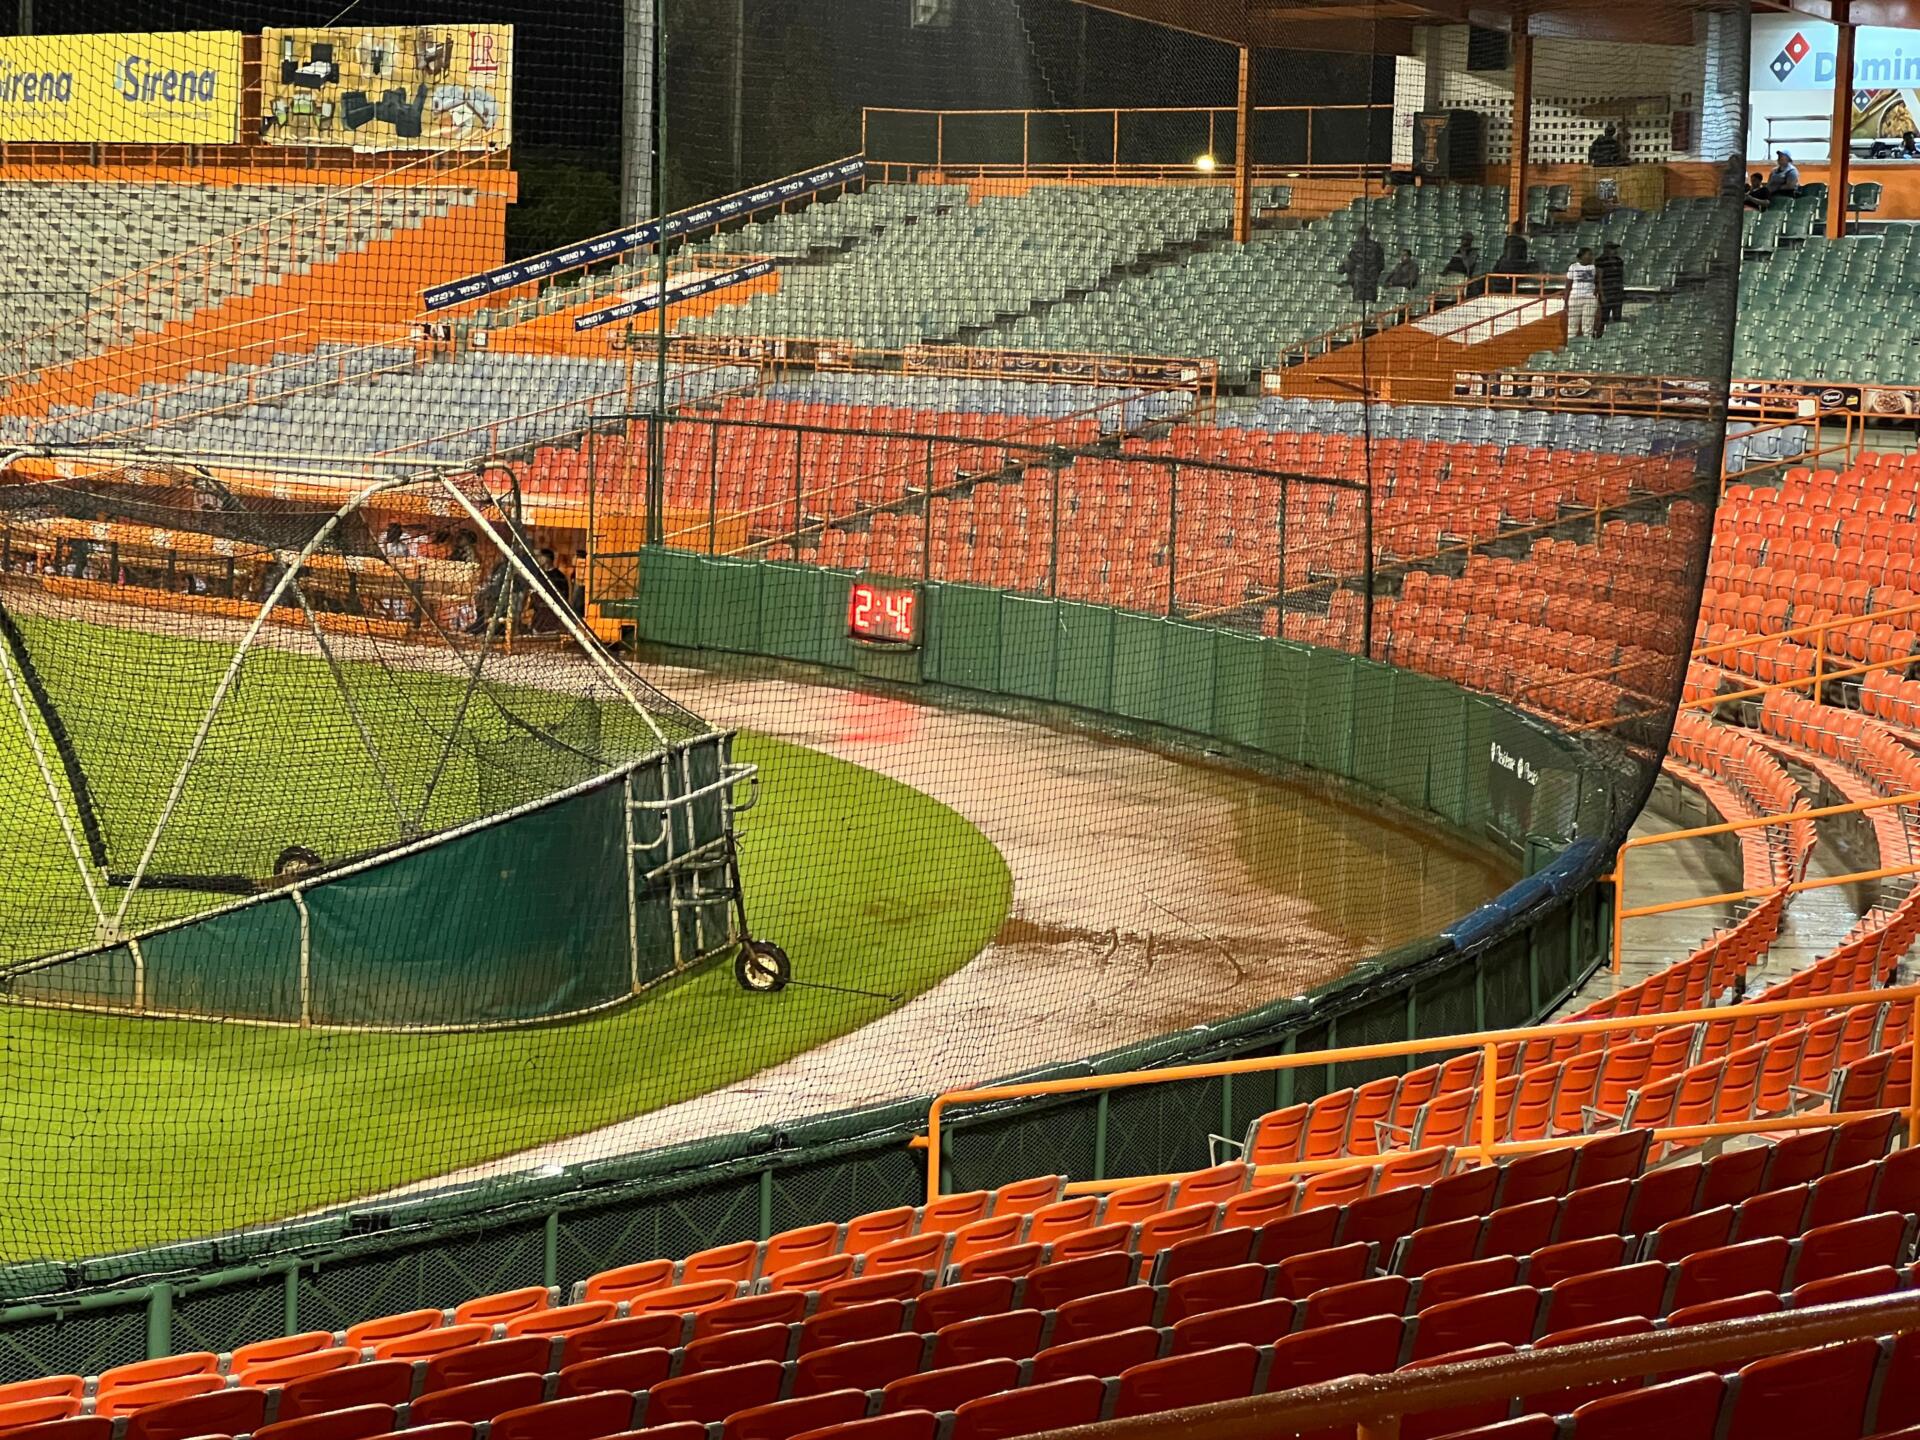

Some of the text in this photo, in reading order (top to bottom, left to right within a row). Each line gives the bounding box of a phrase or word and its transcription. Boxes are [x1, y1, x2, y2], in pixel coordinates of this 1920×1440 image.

[0, 59, 73, 103] irena
[122, 55, 217, 102] Sirena
[1814, 48, 1920, 81] Dmin
[557, 250, 579, 263] WIND
[622, 231, 643, 243] WIND
[654, 221, 676, 233] WND
